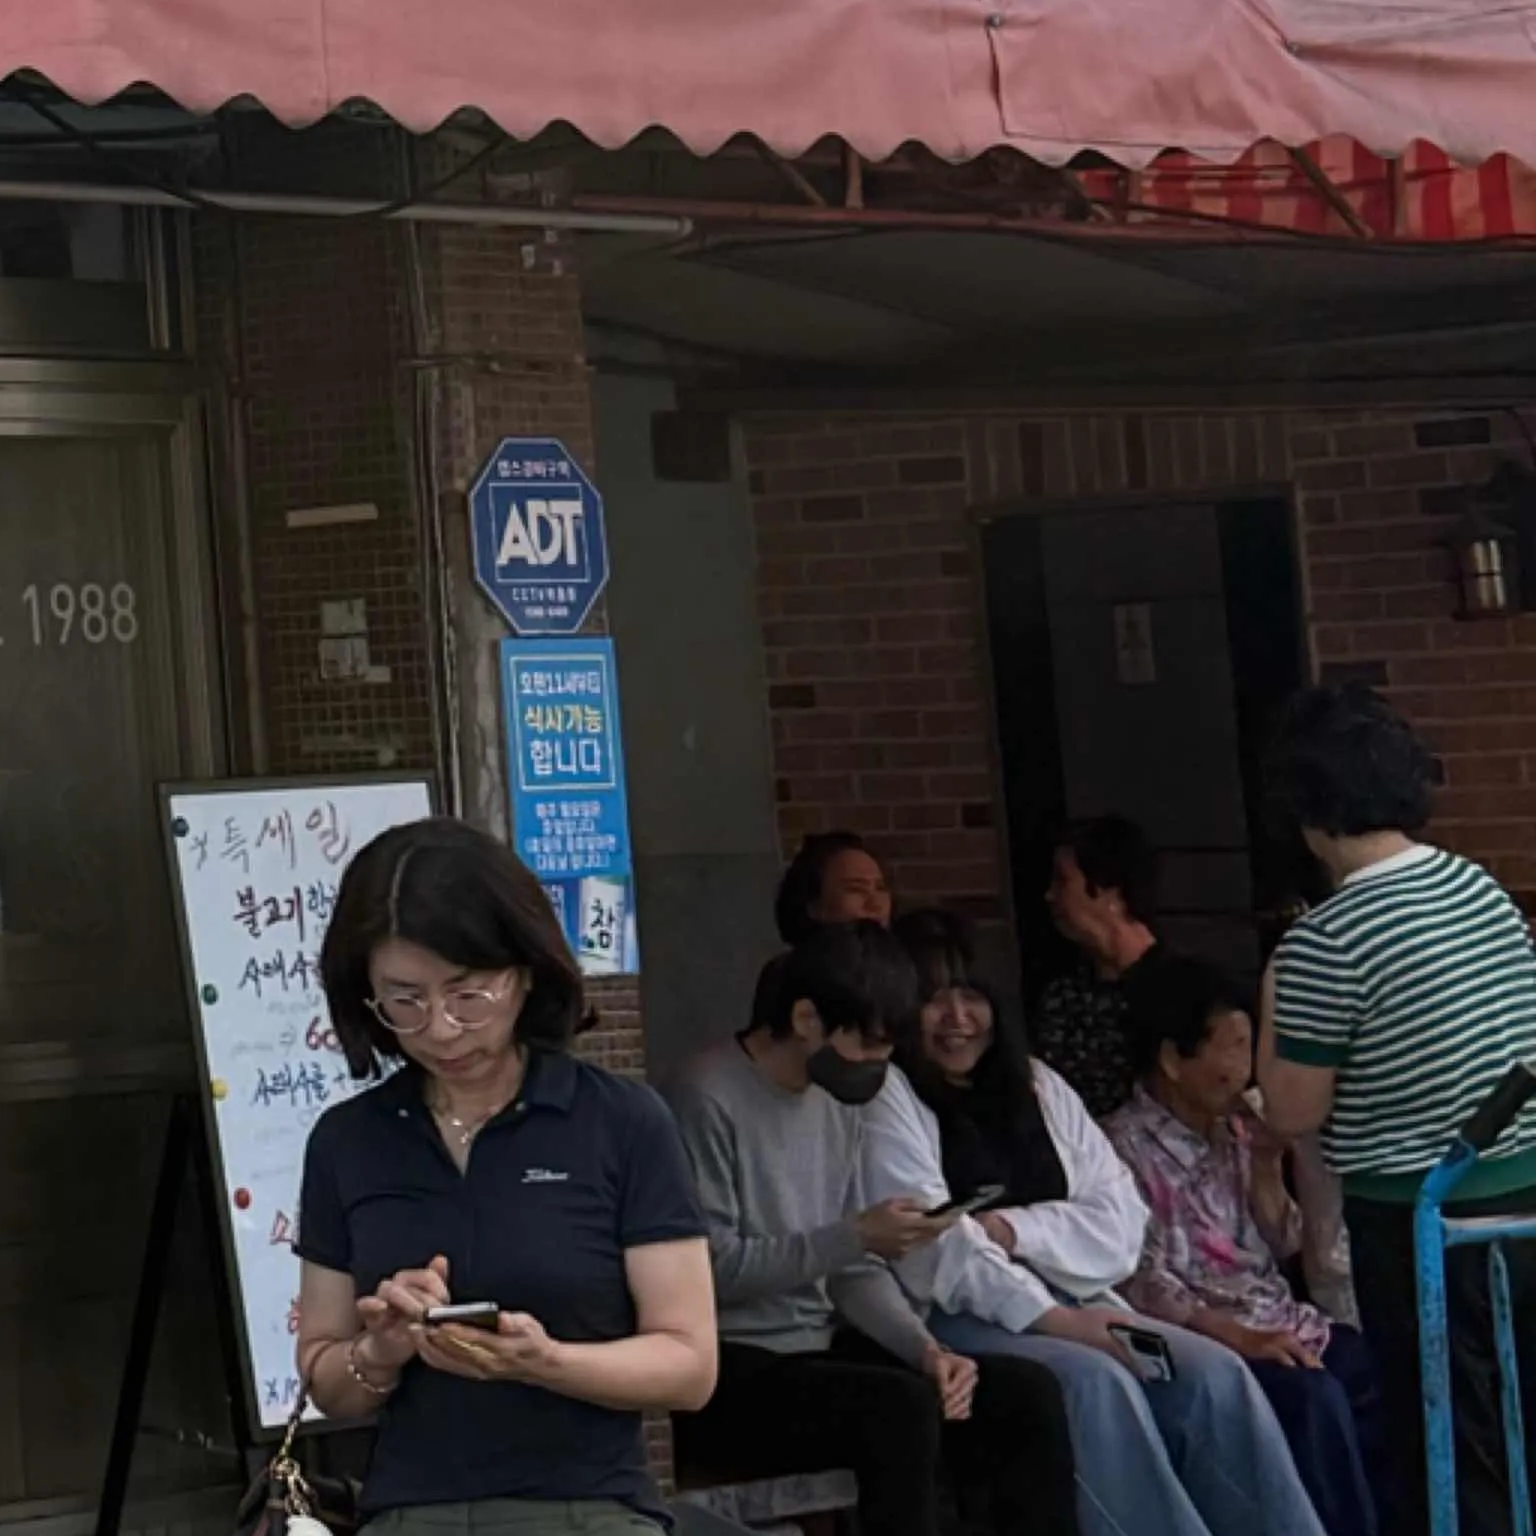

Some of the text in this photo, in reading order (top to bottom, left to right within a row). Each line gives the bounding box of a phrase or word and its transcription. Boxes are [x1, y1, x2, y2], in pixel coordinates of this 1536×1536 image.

[495, 499, 583, 566] ADT
[22, 581, 139, 646] 1988
[529, 738, 602, 776] 합니다
[590, 897, 617, 949] 참
